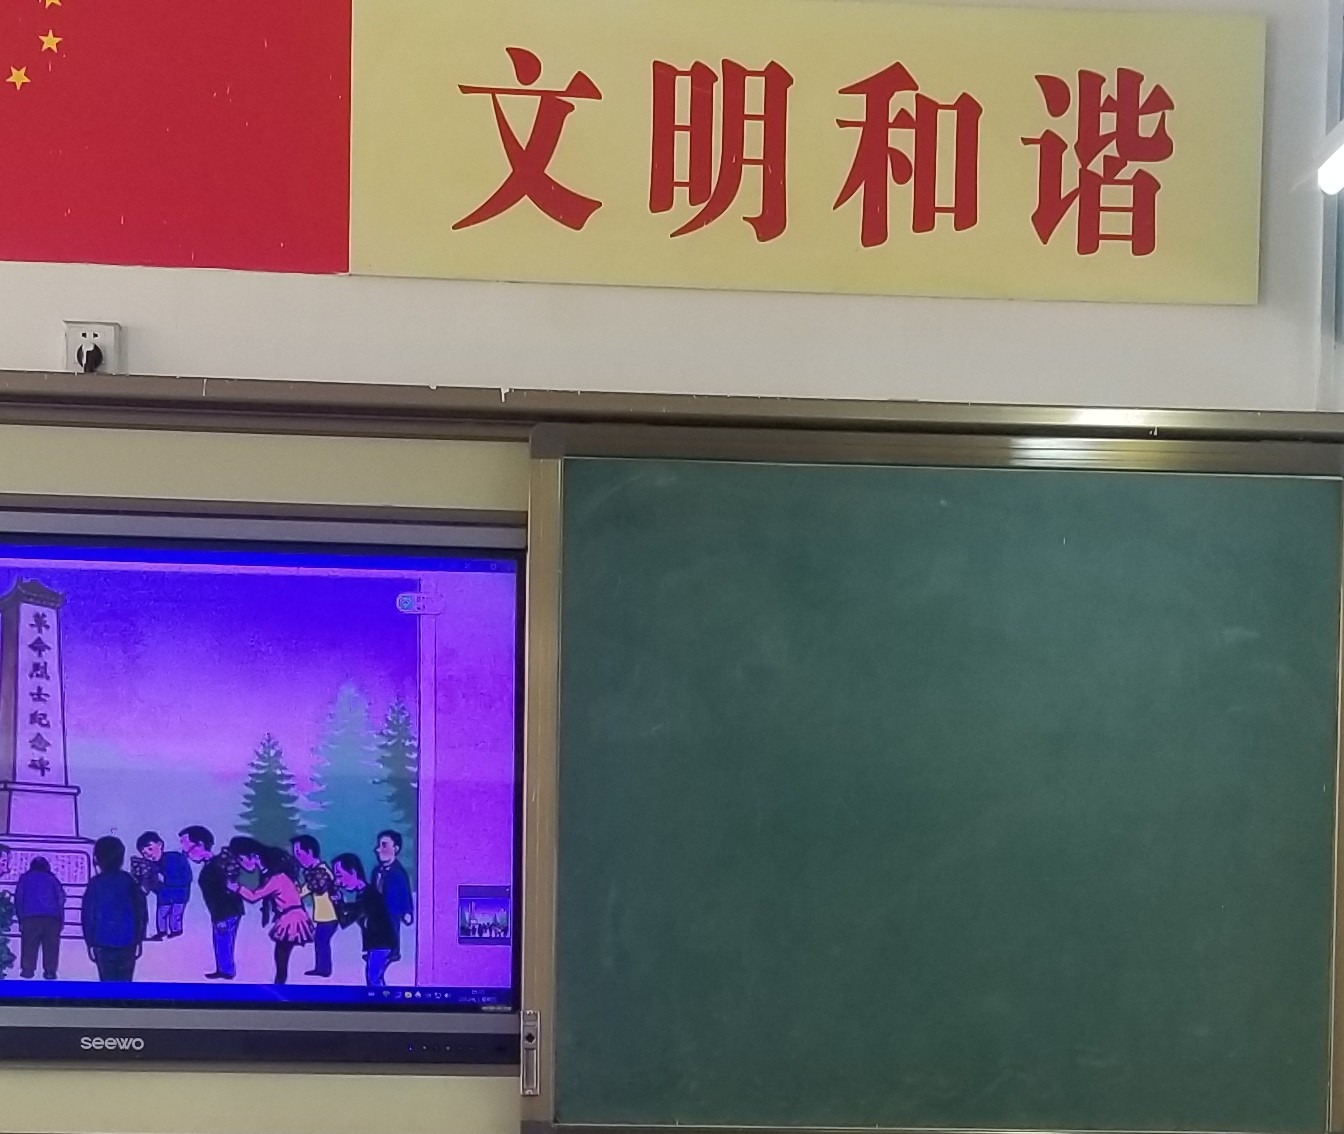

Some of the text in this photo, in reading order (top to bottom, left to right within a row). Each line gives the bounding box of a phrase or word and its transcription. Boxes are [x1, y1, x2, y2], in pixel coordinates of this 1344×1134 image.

[453, 46, 1177, 256] 文明和谐
[27, 611, 53, 777] 革命烈士纪念碑
[80, 1036, 145, 1051] seewo
